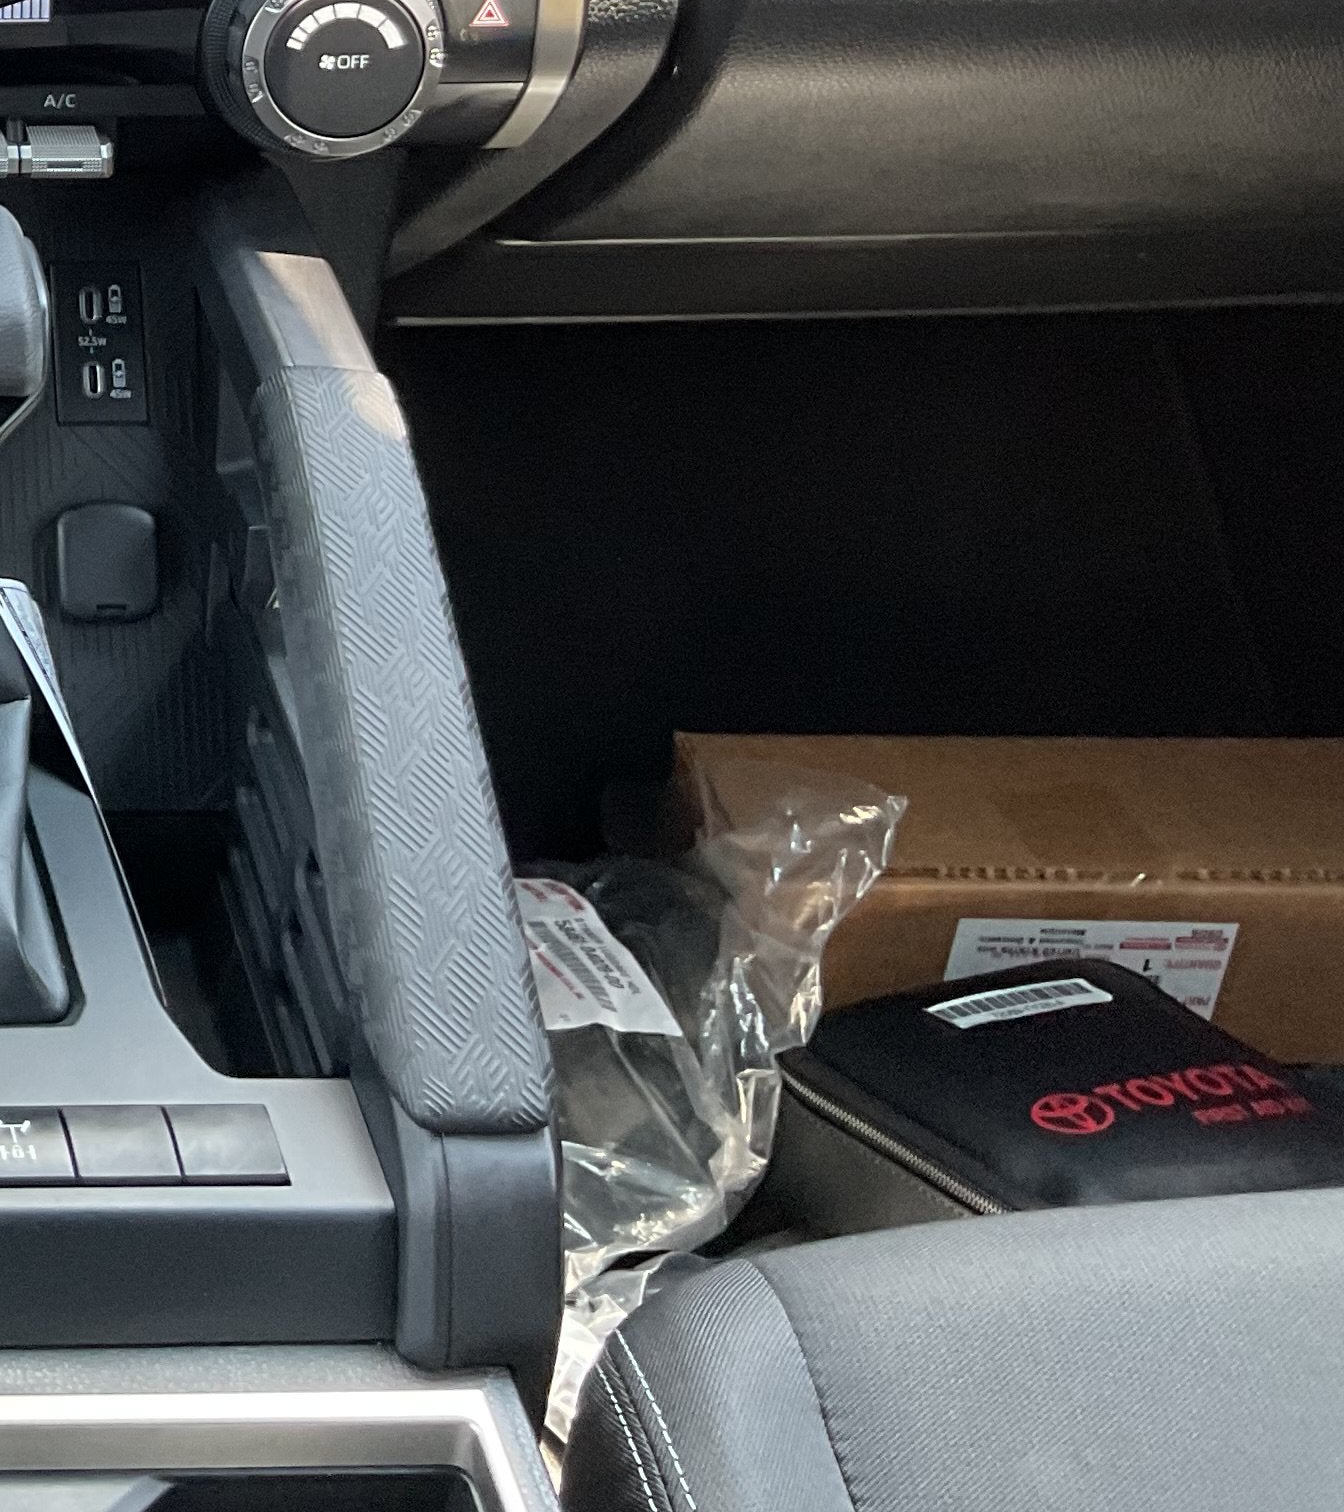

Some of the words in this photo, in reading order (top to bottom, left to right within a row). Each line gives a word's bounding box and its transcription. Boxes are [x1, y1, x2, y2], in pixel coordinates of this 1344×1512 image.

[337, 54, 370, 70] OFF
[43, 93, 76, 108] A/C
[78, 336, 107, 346] 52.5W
[1093, 1063, 1289, 1112] TOYOTA
